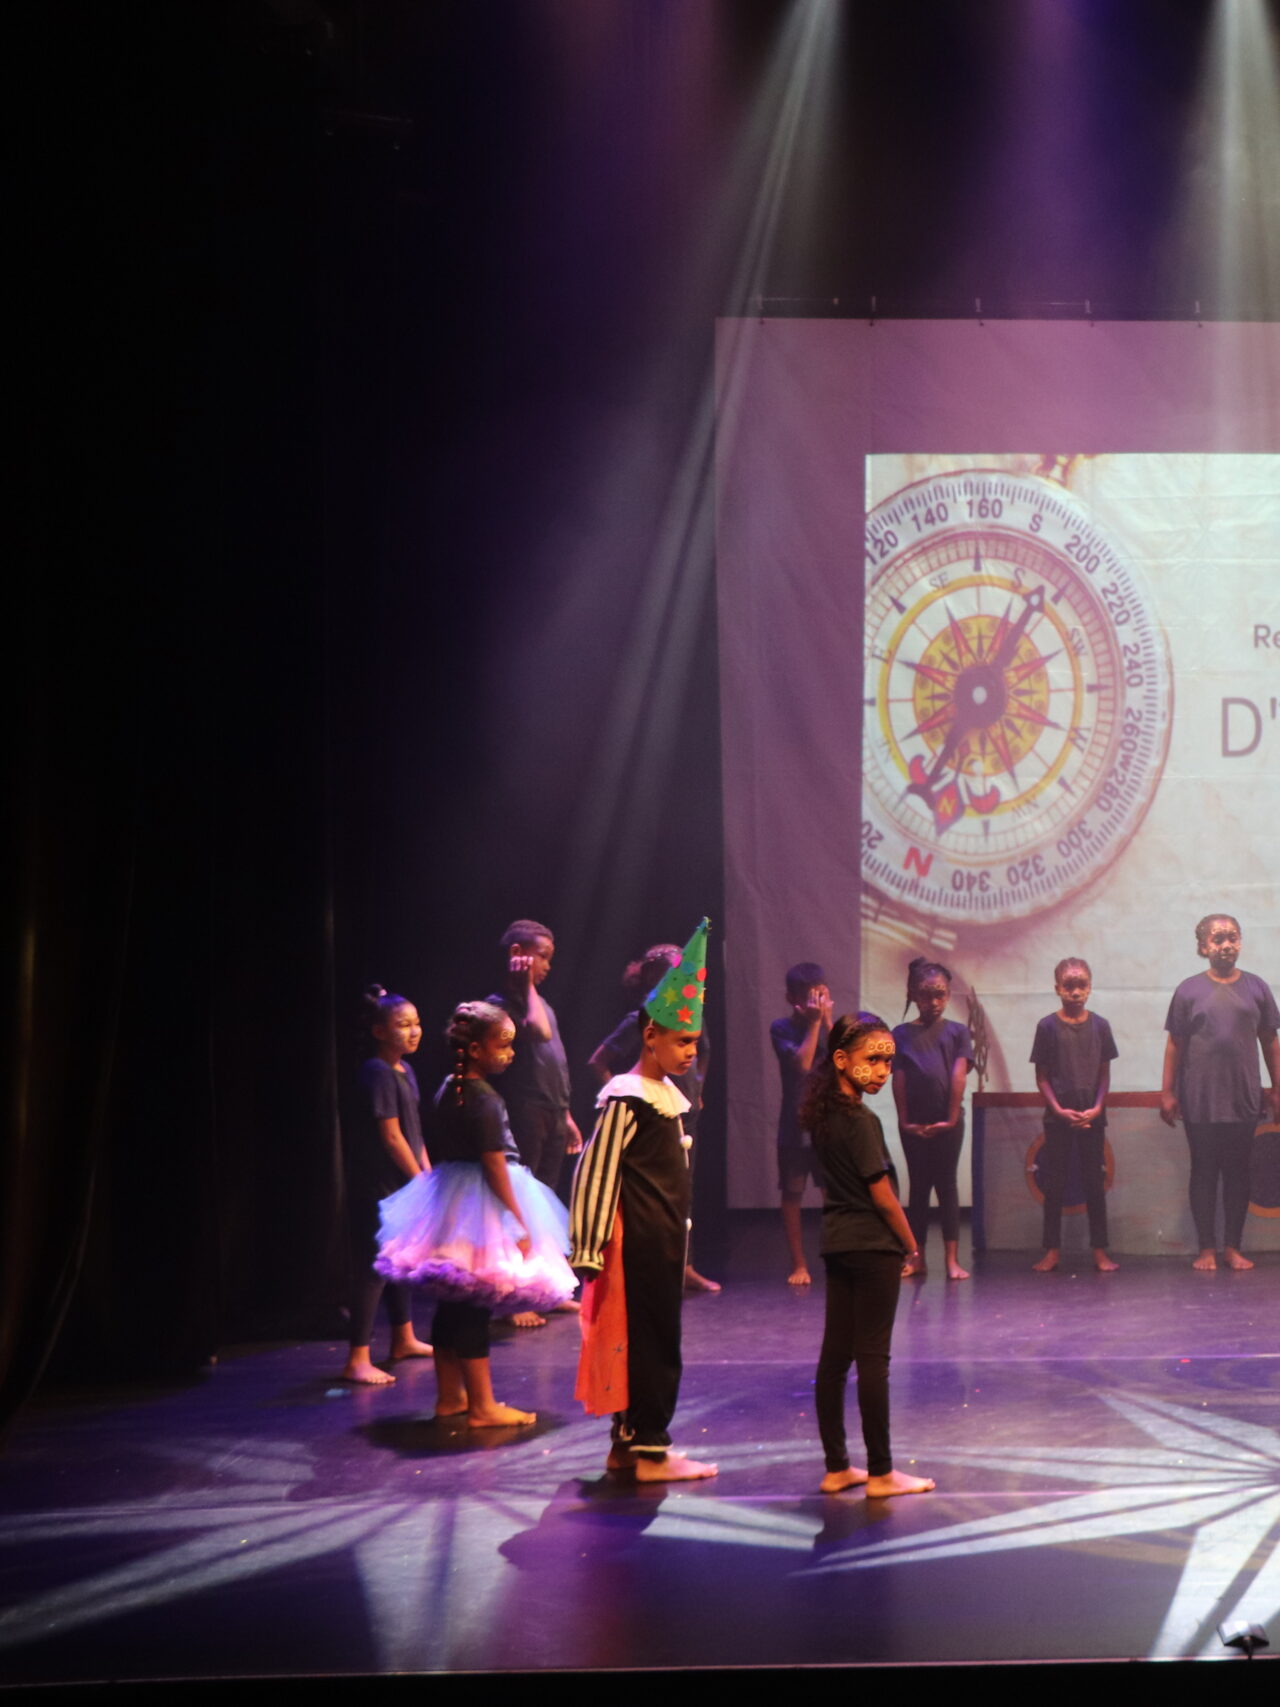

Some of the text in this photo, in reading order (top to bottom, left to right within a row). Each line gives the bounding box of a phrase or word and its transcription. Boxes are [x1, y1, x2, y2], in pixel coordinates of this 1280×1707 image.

[911, 502, 949, 532] 140
[966, 498, 1003, 519] 160
[1029, 513, 1043, 532] S
[864, 530, 899, 566] 120
[1064, 534, 1100, 574] 200
[1101, 582, 1131, 626] 220
[1123, 643, 1144, 688] 240
[1056, 819, 1093, 858] 300
[902, 846, 934, 877] N
[1006, 854, 1046, 886] 320
[951, 869, 991, 893] 340
